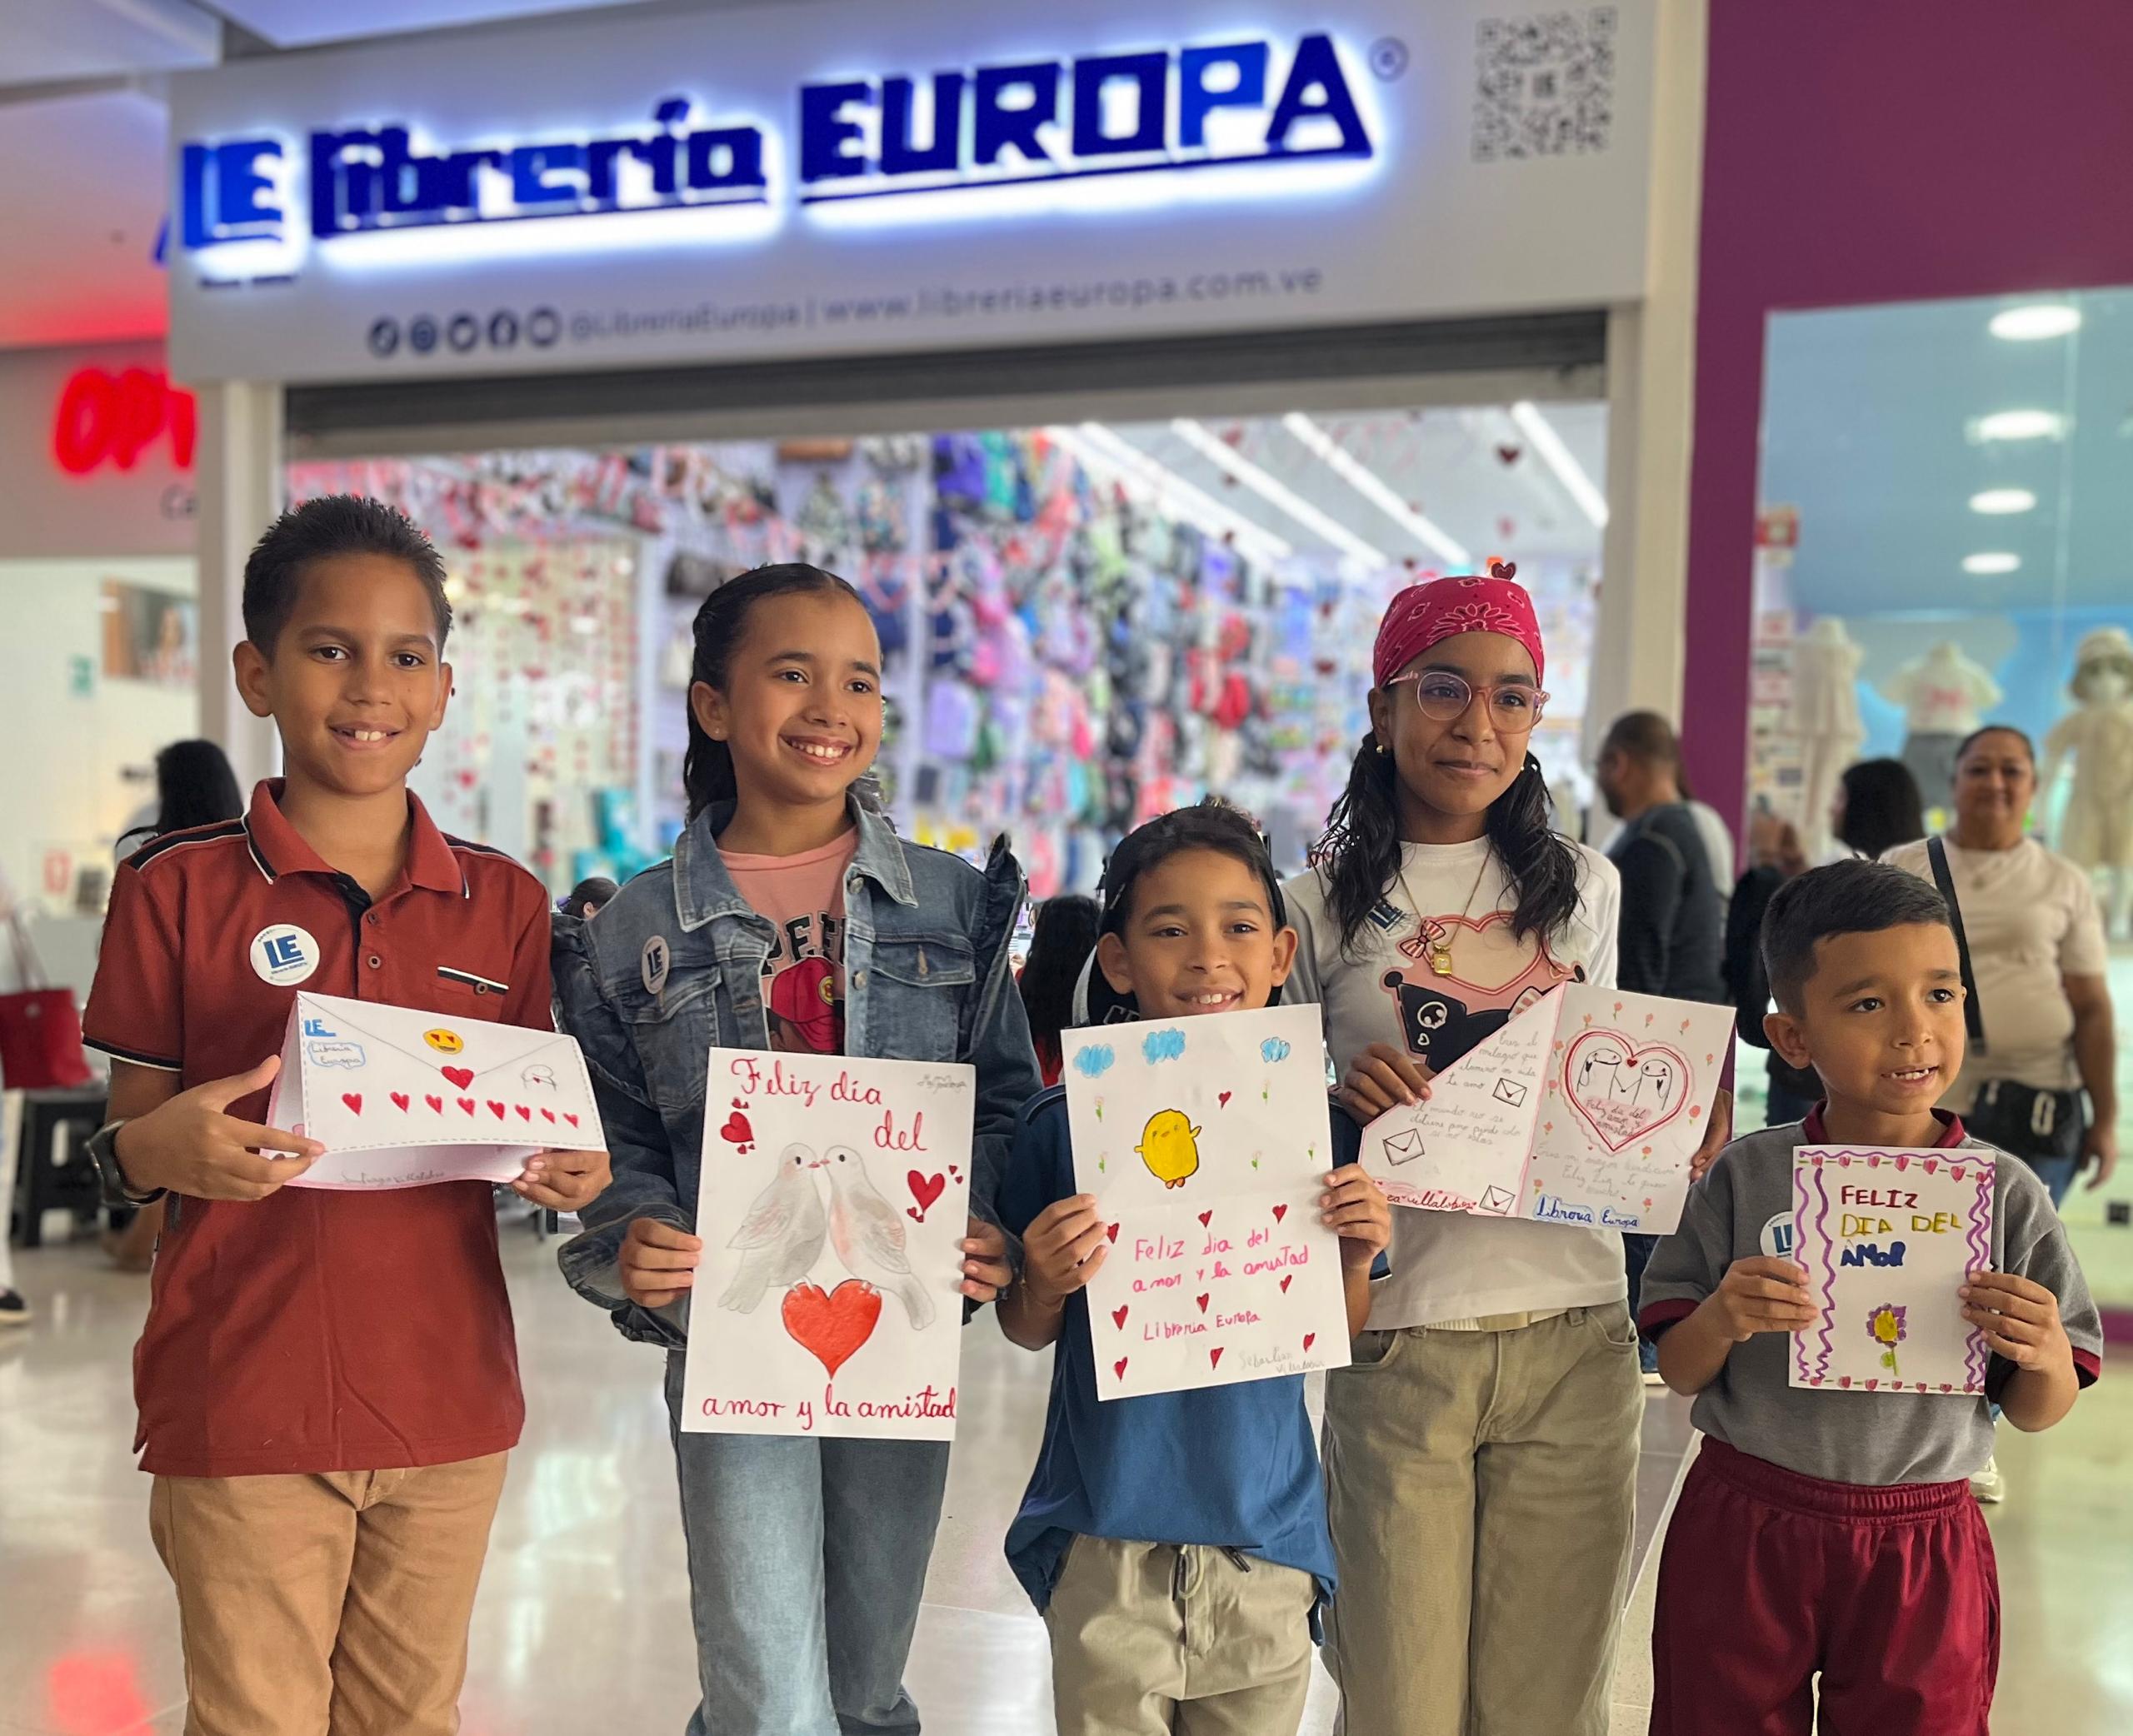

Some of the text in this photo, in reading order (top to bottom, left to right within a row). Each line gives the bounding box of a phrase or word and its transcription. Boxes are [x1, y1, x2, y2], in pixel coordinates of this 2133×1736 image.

[799, 33, 1373, 205] EUROPA
[263, 935, 305, 969] LE
[731, 1058, 822, 1107] Feliz
[875, 1110, 927, 1151] del
[1841, 1185, 1919, 1209] FELIZ
[1247, 1227, 1269, 1248] del
[1841, 1212, 1963, 1237] DIA DEL
[1131, 1274, 1181, 1292] amor
[1211, 1261, 1232, 1280] la
[702, 1384, 957, 1431] amor y la amistad
